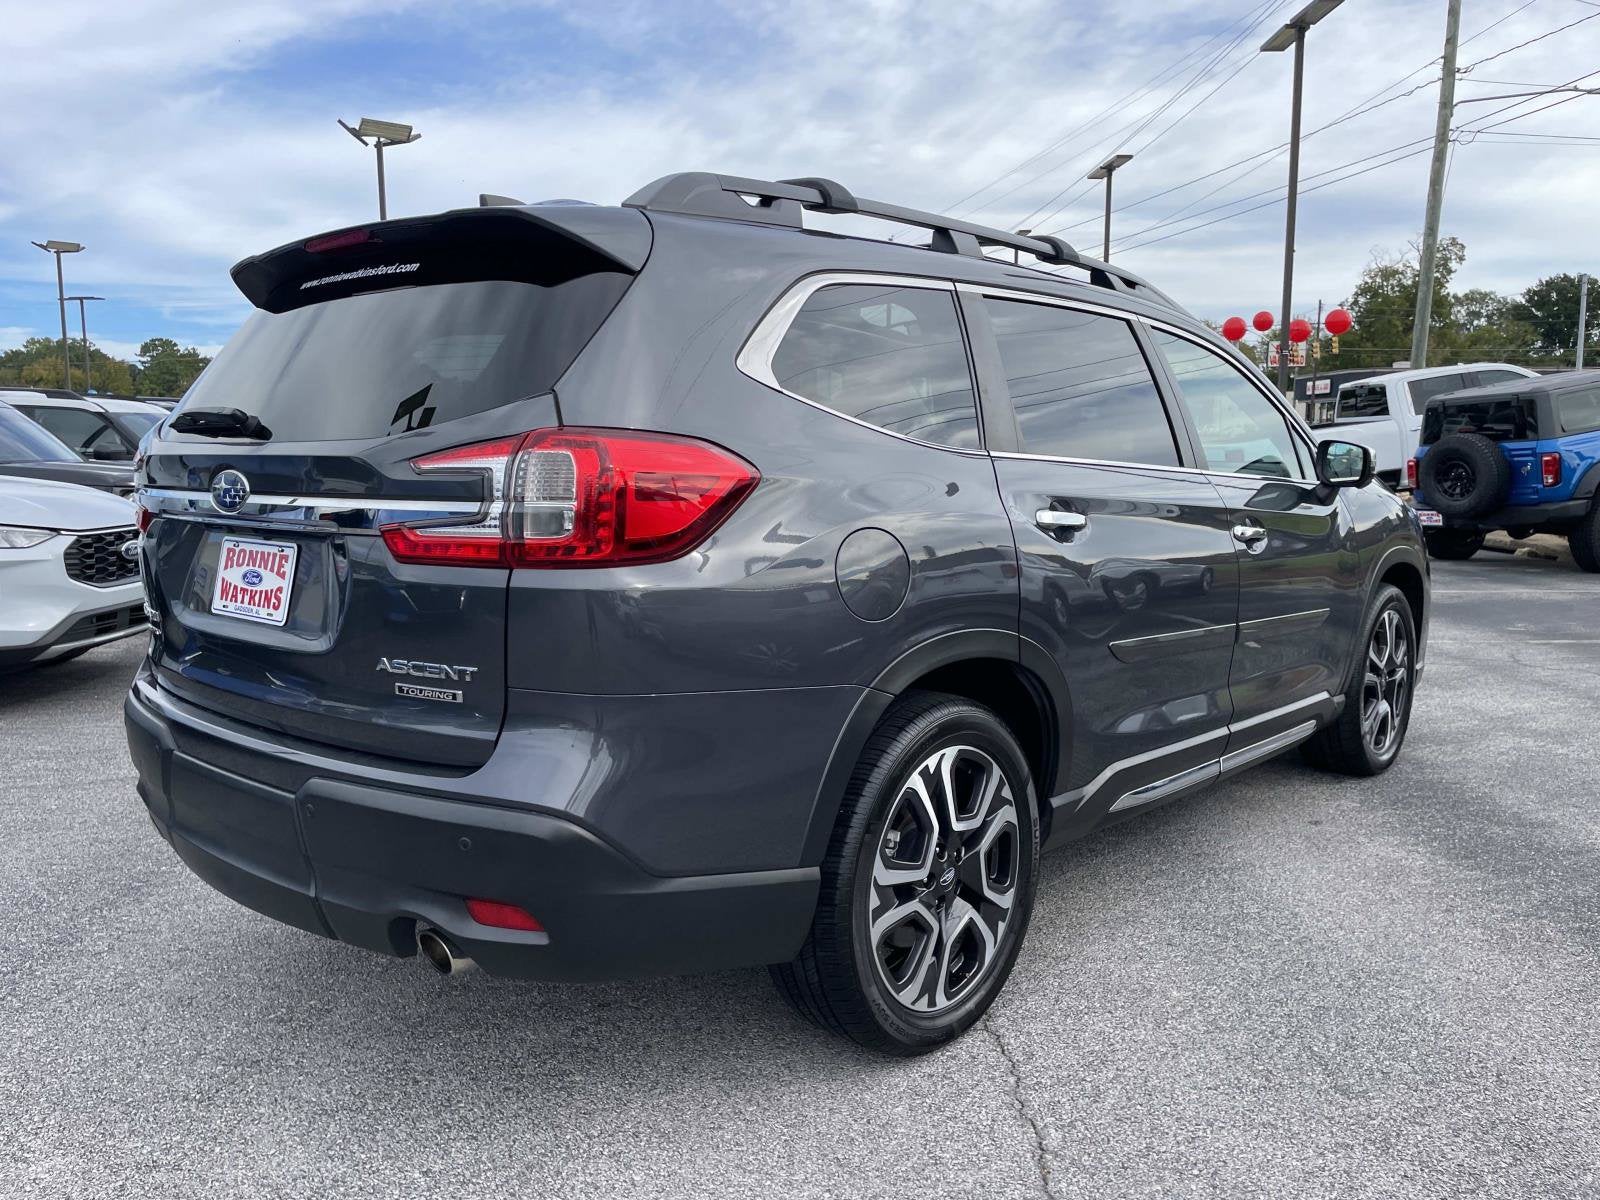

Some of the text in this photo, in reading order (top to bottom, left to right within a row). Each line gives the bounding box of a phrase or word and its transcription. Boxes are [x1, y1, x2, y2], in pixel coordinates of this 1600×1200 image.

[300, 262, 420, 290] www.ronniewatkinsford.com
[223, 547, 289, 581] RONNIE
[244, 571, 261, 585] Ford
[220, 576, 284, 612] WATKINS
[376, 657, 478, 681] ASCENT
[402, 686, 453, 700] TOURING
